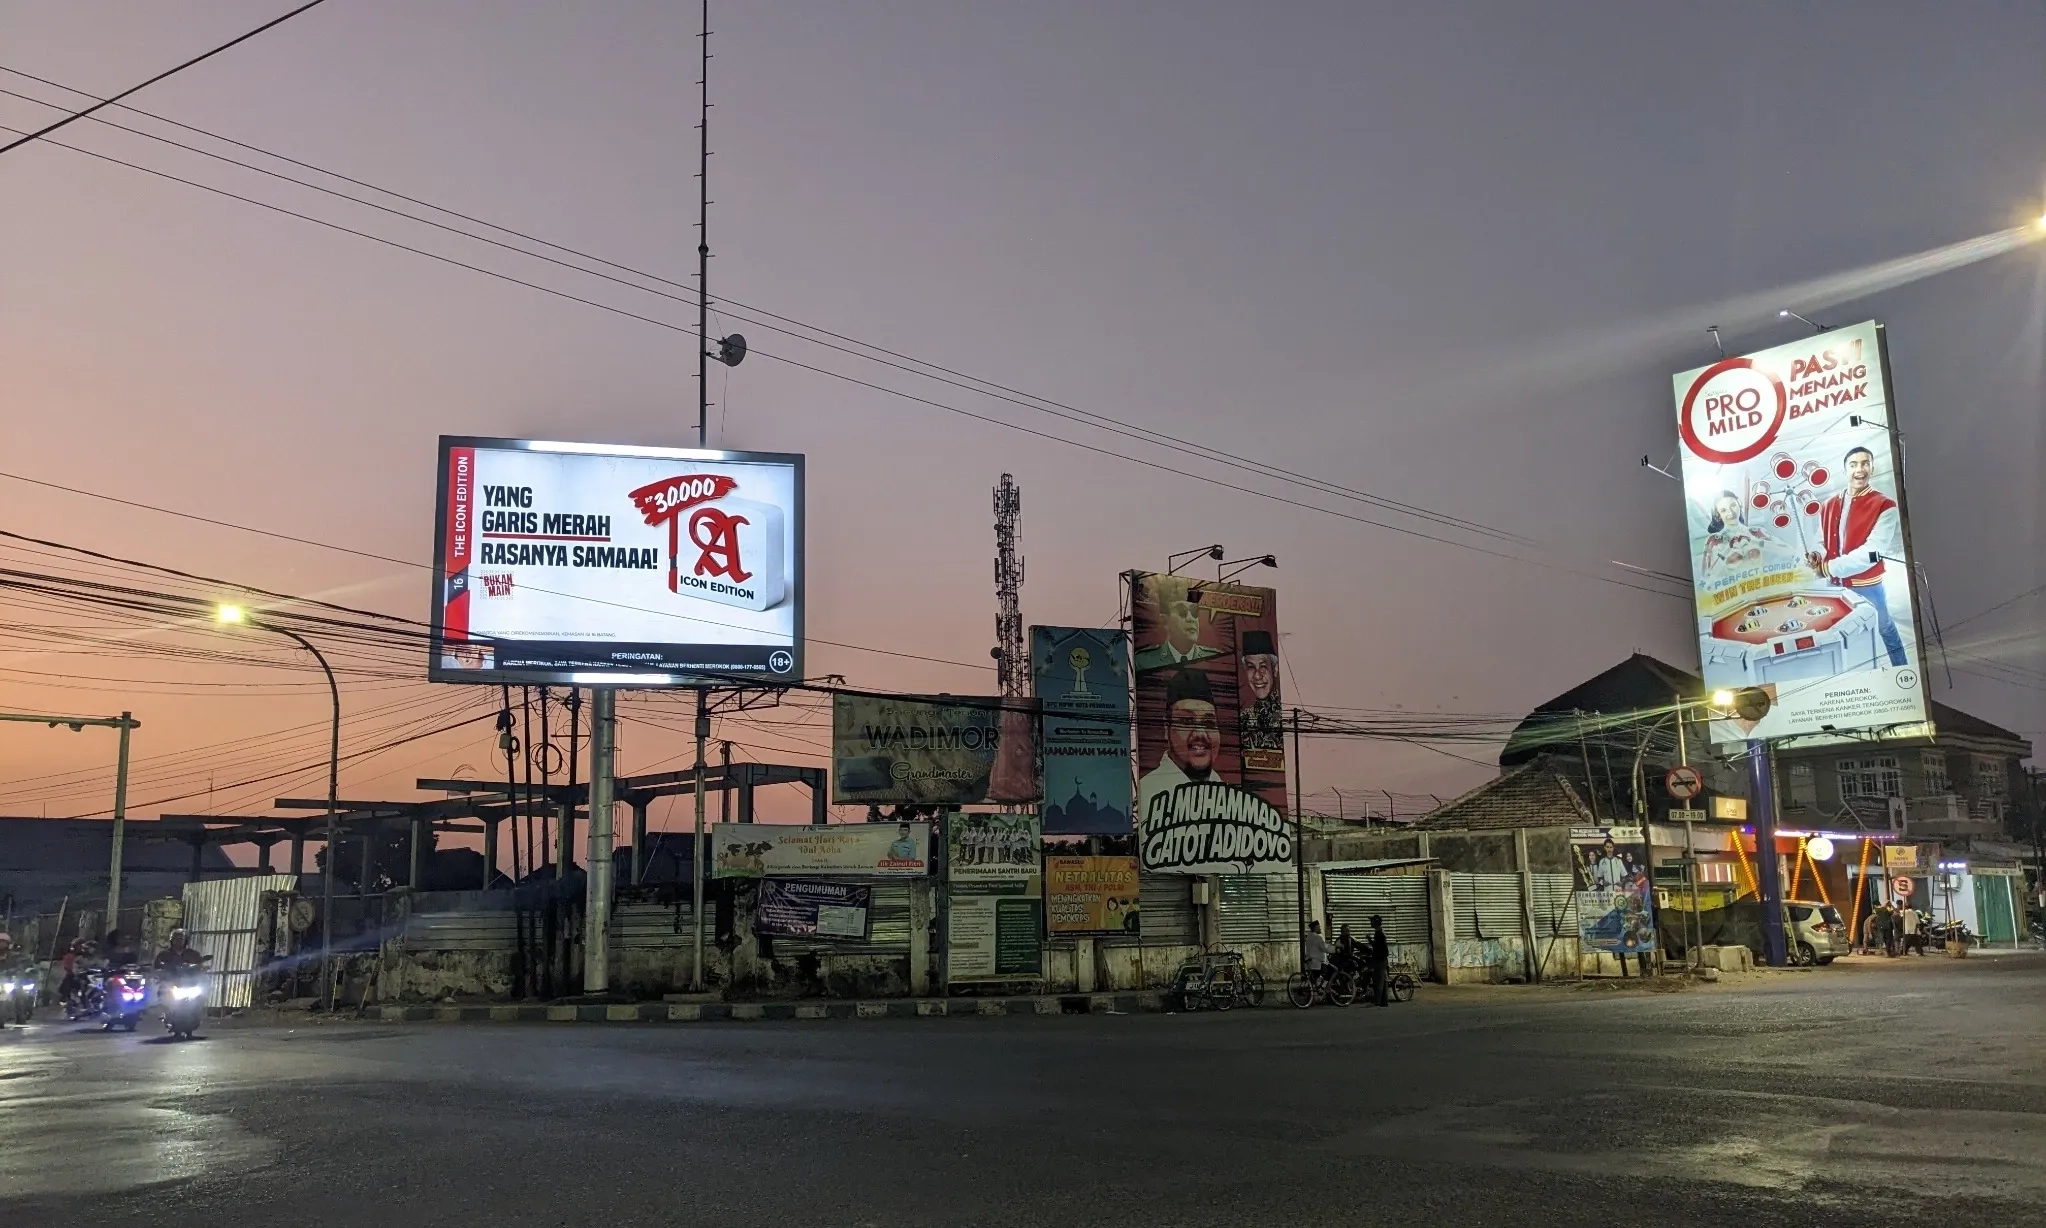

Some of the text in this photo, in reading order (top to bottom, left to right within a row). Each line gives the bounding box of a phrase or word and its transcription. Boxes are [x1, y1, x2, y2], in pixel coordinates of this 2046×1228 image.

[1789, 364, 1867, 400] MENANG
[1706, 388, 1760, 421] PRO
[1789, 382, 1869, 420] BANYAK
[1709, 411, 1762, 436] MILD
[483, 485, 532, 508] YANG
[455, 456, 468, 557] THE ICON EDITION
[482, 510, 611, 537] GARIS MERAH
[481, 542, 658, 569] RASANYA SAMAAA!
[454, 578, 464, 590] 16
[483, 573, 513, 587] BUKAN
[680, 575, 755, 600] ICON EDITION
[1713, 571, 1794, 605] WIN THE QUEEN
[1715, 567, 1760, 590] PERFECT
[488, 584, 511, 597] MAIN
[612, 652, 664, 660] PERINGATAN:
[772, 657, 790, 667] 18+
[1824, 687, 1872, 698] PERINGATAN:
[1845, 694, 1879, 703] MEROKOK,
[1806, 707, 1835, 715] TERKENA
[1835, 704, 1861, 712] KANKER
[1862, 697, 1912, 708] TENGGOROKAN
[1789, 716, 1813, 724] LAYANAN
[1815, 712, 1843, 721] BERHENTI
[1843, 709, 1873, 718] MEROKOK
[865, 725, 1000, 751] WADIMOR
[890, 761, 973, 780] Grandmaster
[1172, 784, 1282, 832] MUHAMMAD
[778, 835, 812, 845] Selamat
[814, 834, 836, 845] Hari
[1146, 823, 1291, 866] GATOT ADIDOYO
[799, 845, 819, 854] Idul
[1055, 870, 1132, 883] NETRALITAS
[785, 882, 847, 896] PENGUMUMAN
[1052, 913, 1091, 923] DEMOKRASI
